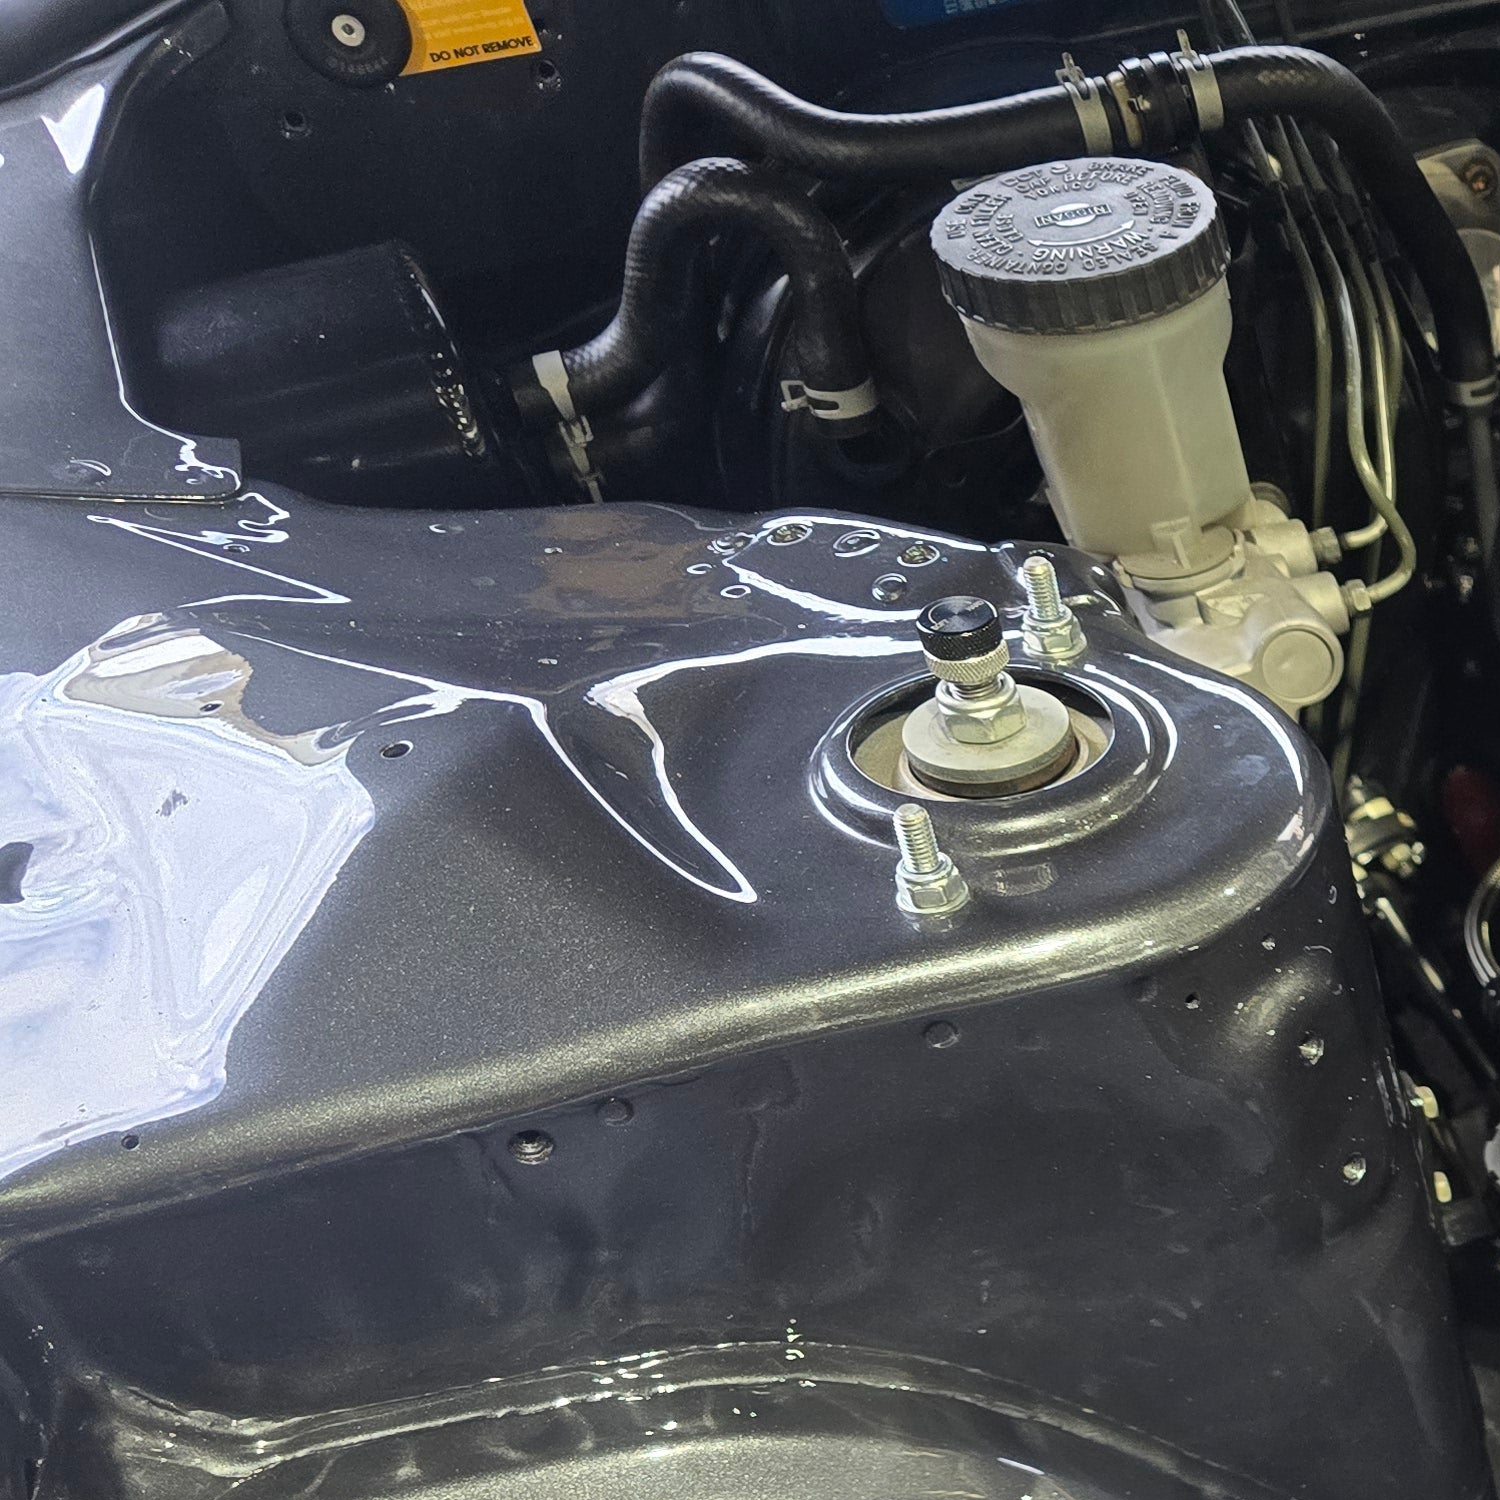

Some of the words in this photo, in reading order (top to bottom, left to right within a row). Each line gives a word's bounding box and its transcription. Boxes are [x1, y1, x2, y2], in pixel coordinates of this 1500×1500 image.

[430, 51, 451, 62] DO
[453, 45, 481, 59] NOT
[482, 36, 535, 53] REMOVE
[1064, 170, 1140, 186] BEFORE
[1088, 162, 1154, 177] BRAKE
[945, 219, 966, 240] USE
[972, 227, 1014, 255] CLEAN
[1031, 231, 1150, 262] WARNING
[1083, 241, 1158, 272] SEALED
